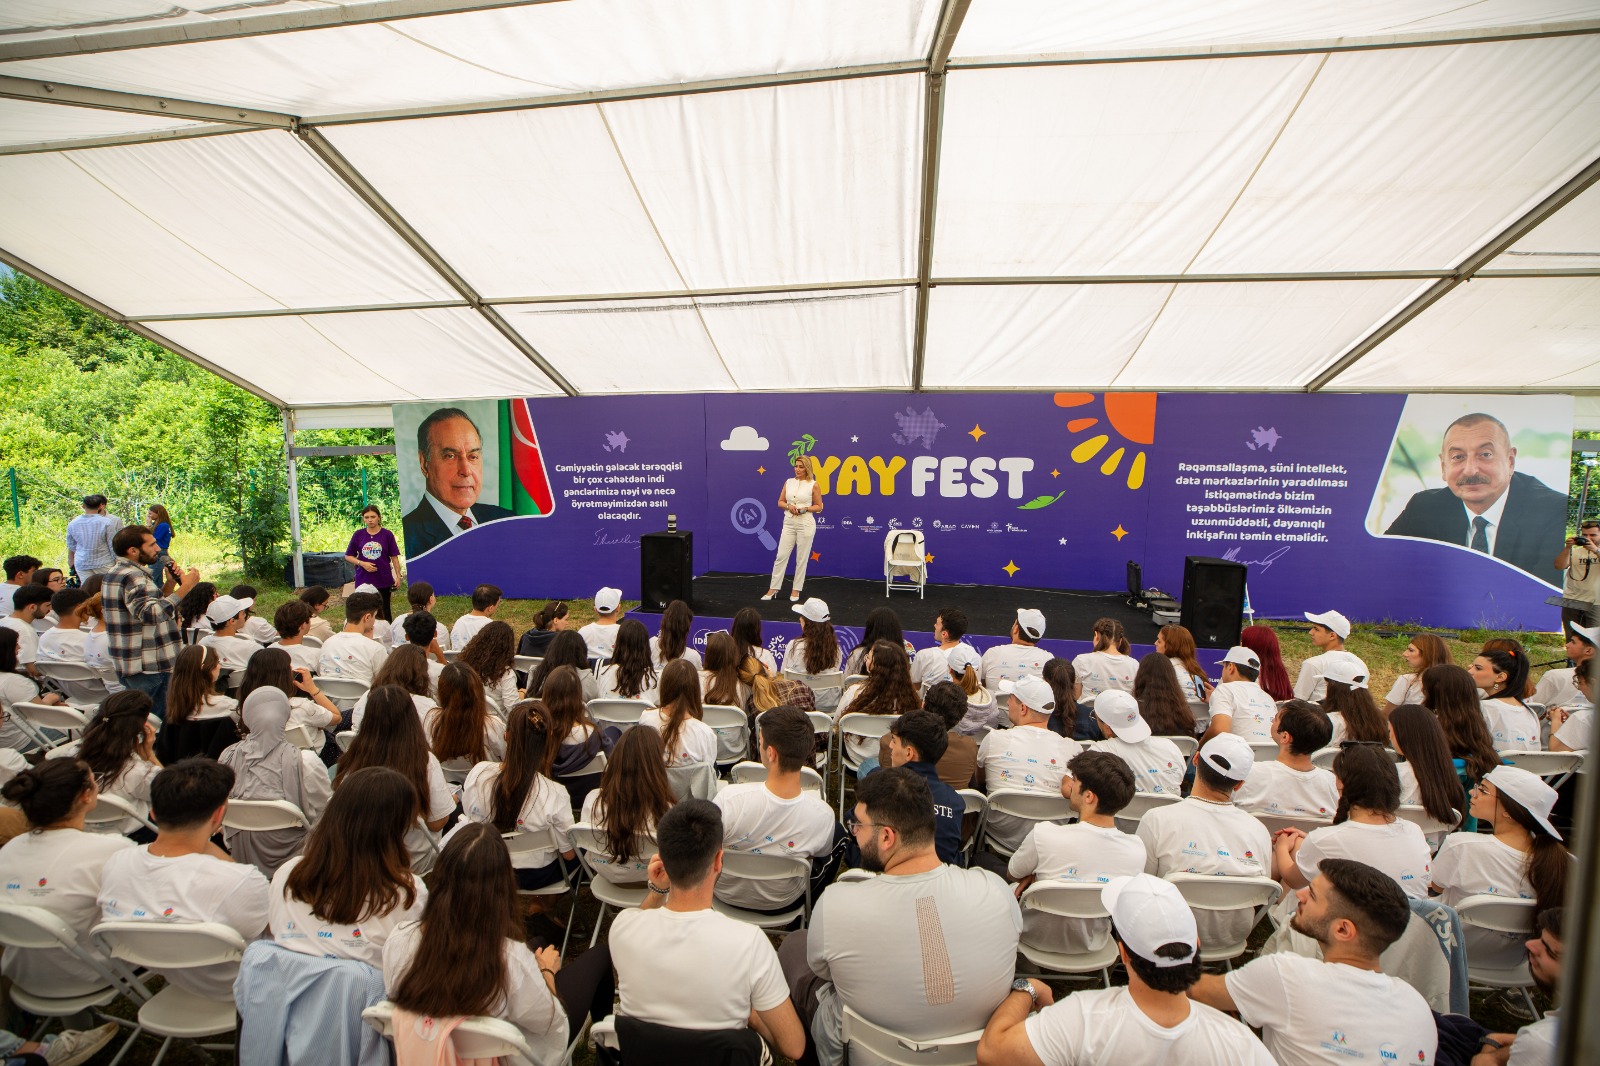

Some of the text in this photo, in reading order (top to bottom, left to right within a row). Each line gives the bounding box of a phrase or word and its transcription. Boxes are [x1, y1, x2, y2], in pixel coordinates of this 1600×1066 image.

[1270, 462, 1294, 472] süni
[1296, 463, 1348, 474] intellekt,
[574, 476, 586, 484] bir
[648, 474, 665, 483] indi
[1176, 476, 1201, 485] data
[1282, 478, 1348, 488] yaradılması
[1284, 491, 1315, 500] bizim
[650, 500, 668, 508] asılı
[598, 512, 642, 521] olacaqdır.
[1273, 518, 1325, 530] dayanıqlı
[1186, 530, 1238, 541] inkişafını
